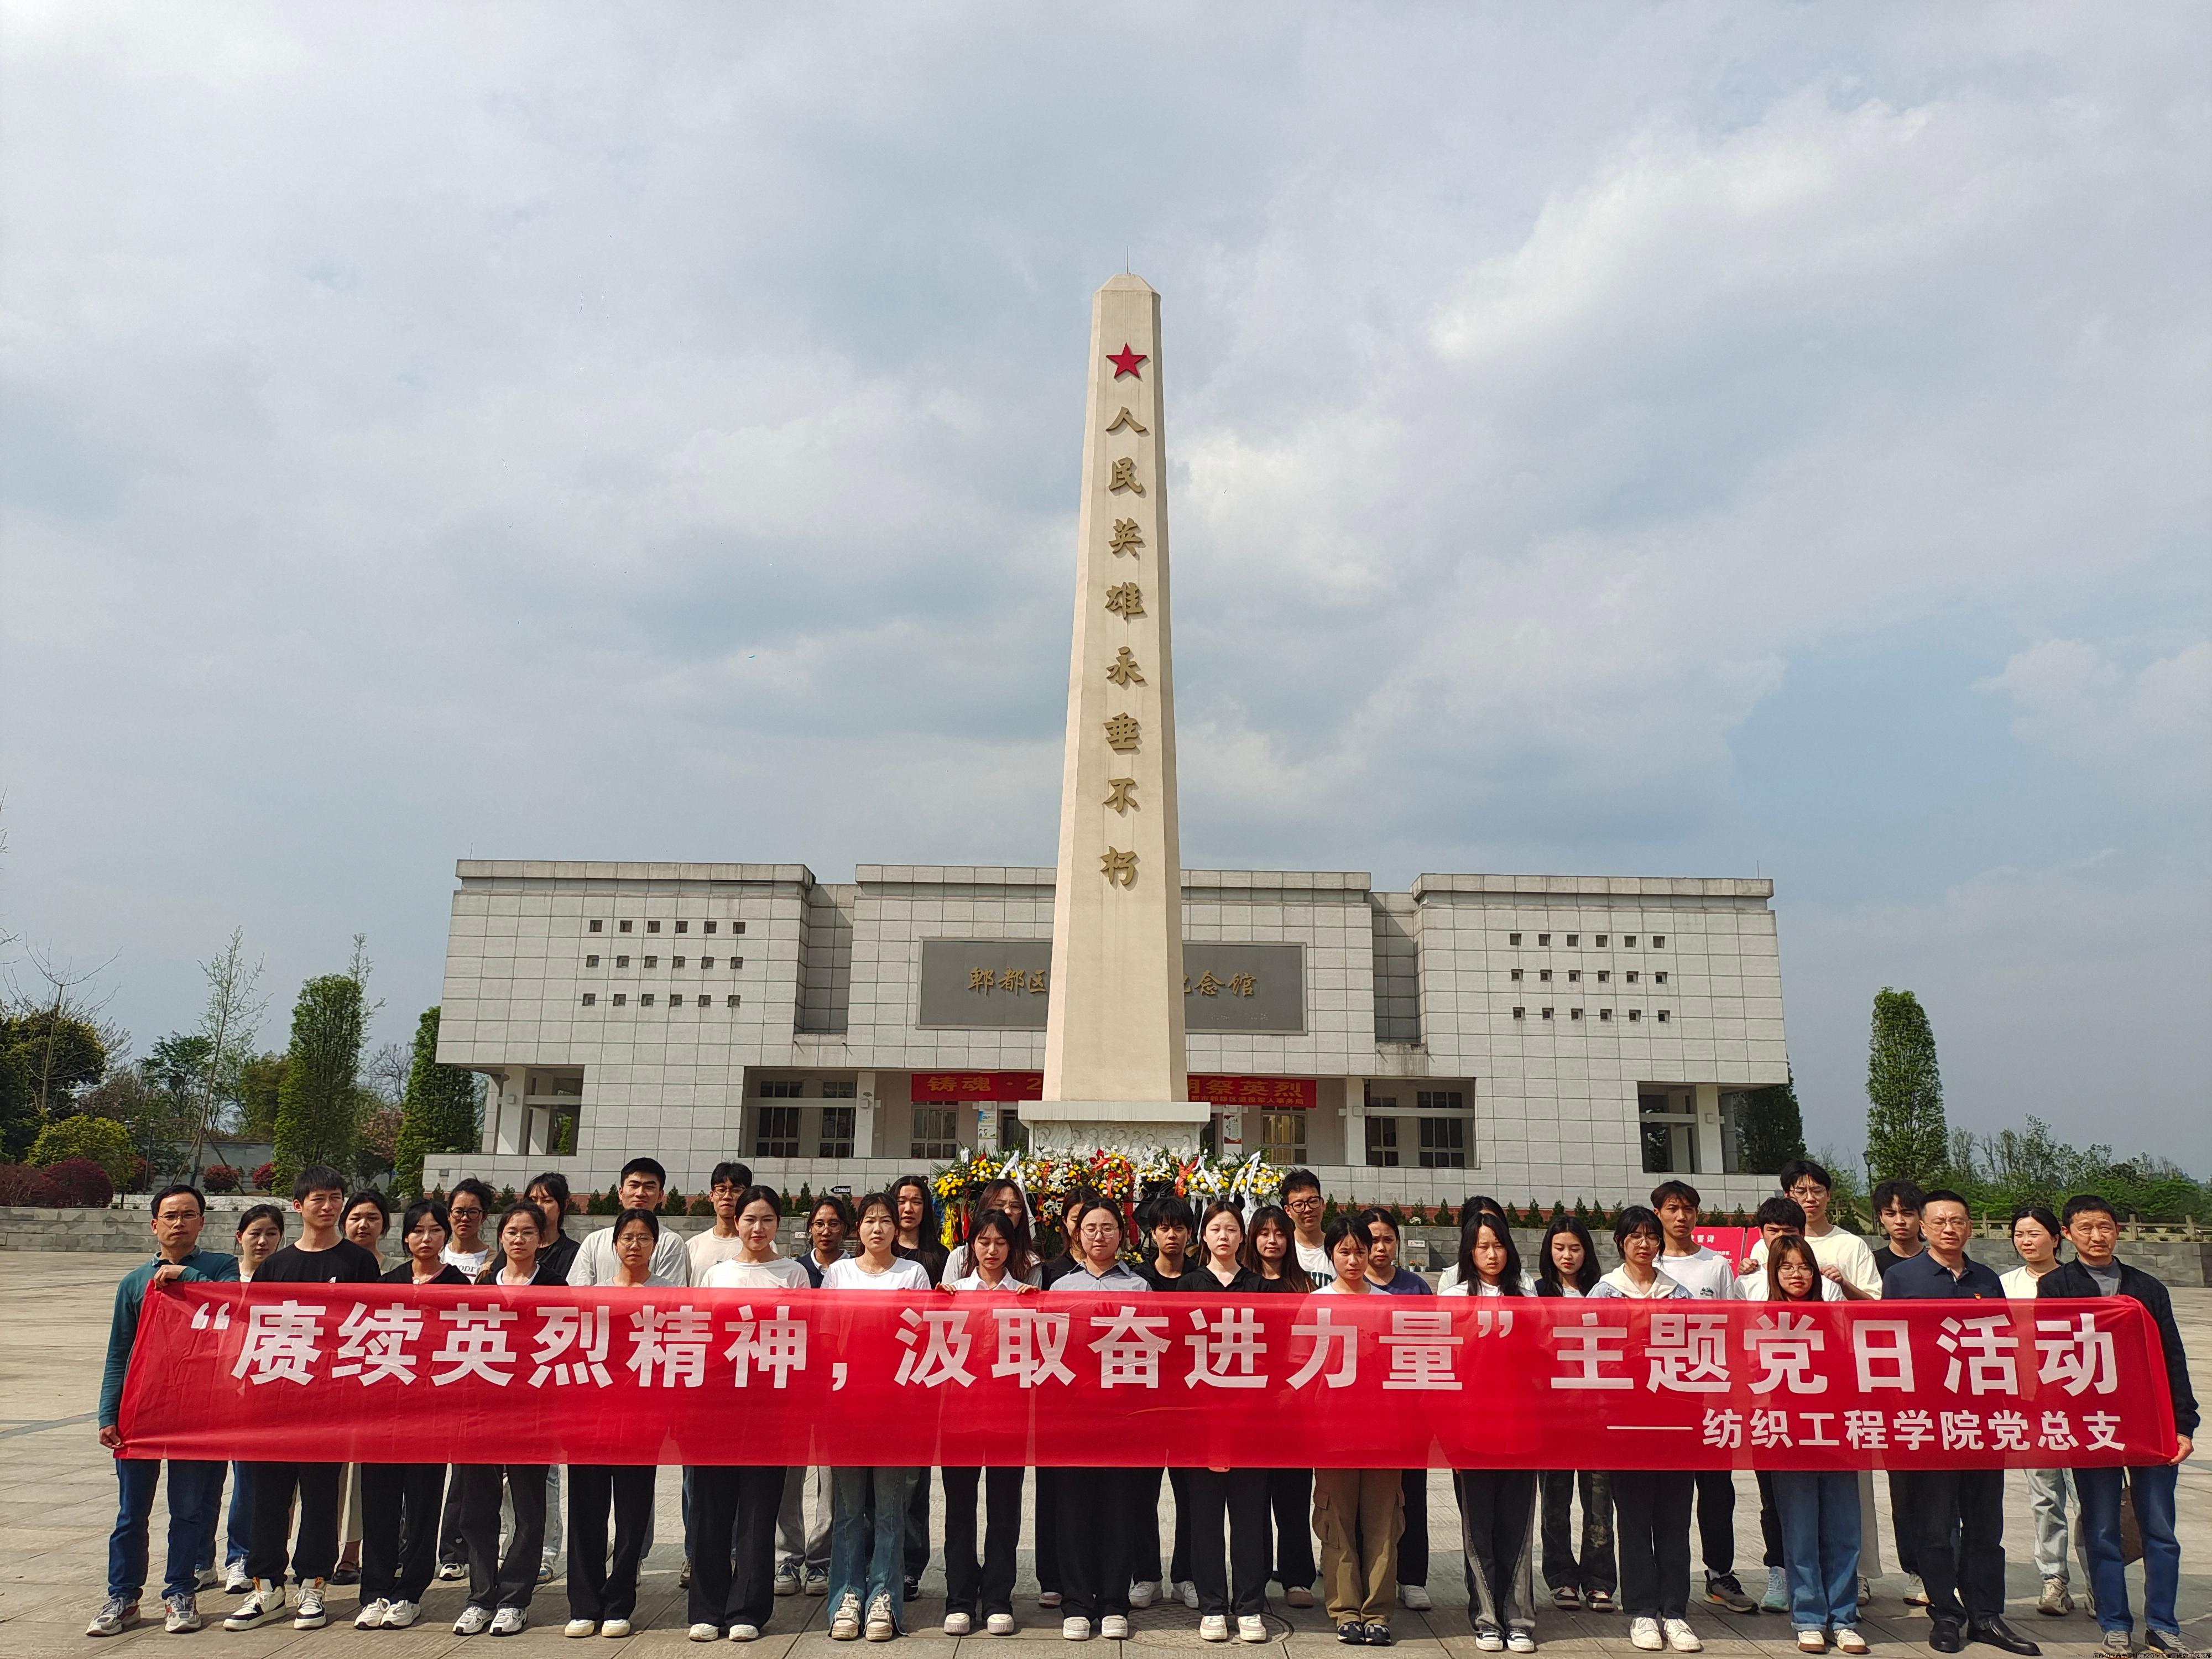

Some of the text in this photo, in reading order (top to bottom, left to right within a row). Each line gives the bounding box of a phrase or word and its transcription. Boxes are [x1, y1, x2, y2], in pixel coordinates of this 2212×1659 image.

[1100, 406, 1146, 885] 人民英雄永垂不朽
[968, 966, 1046, 995] 郫都区
